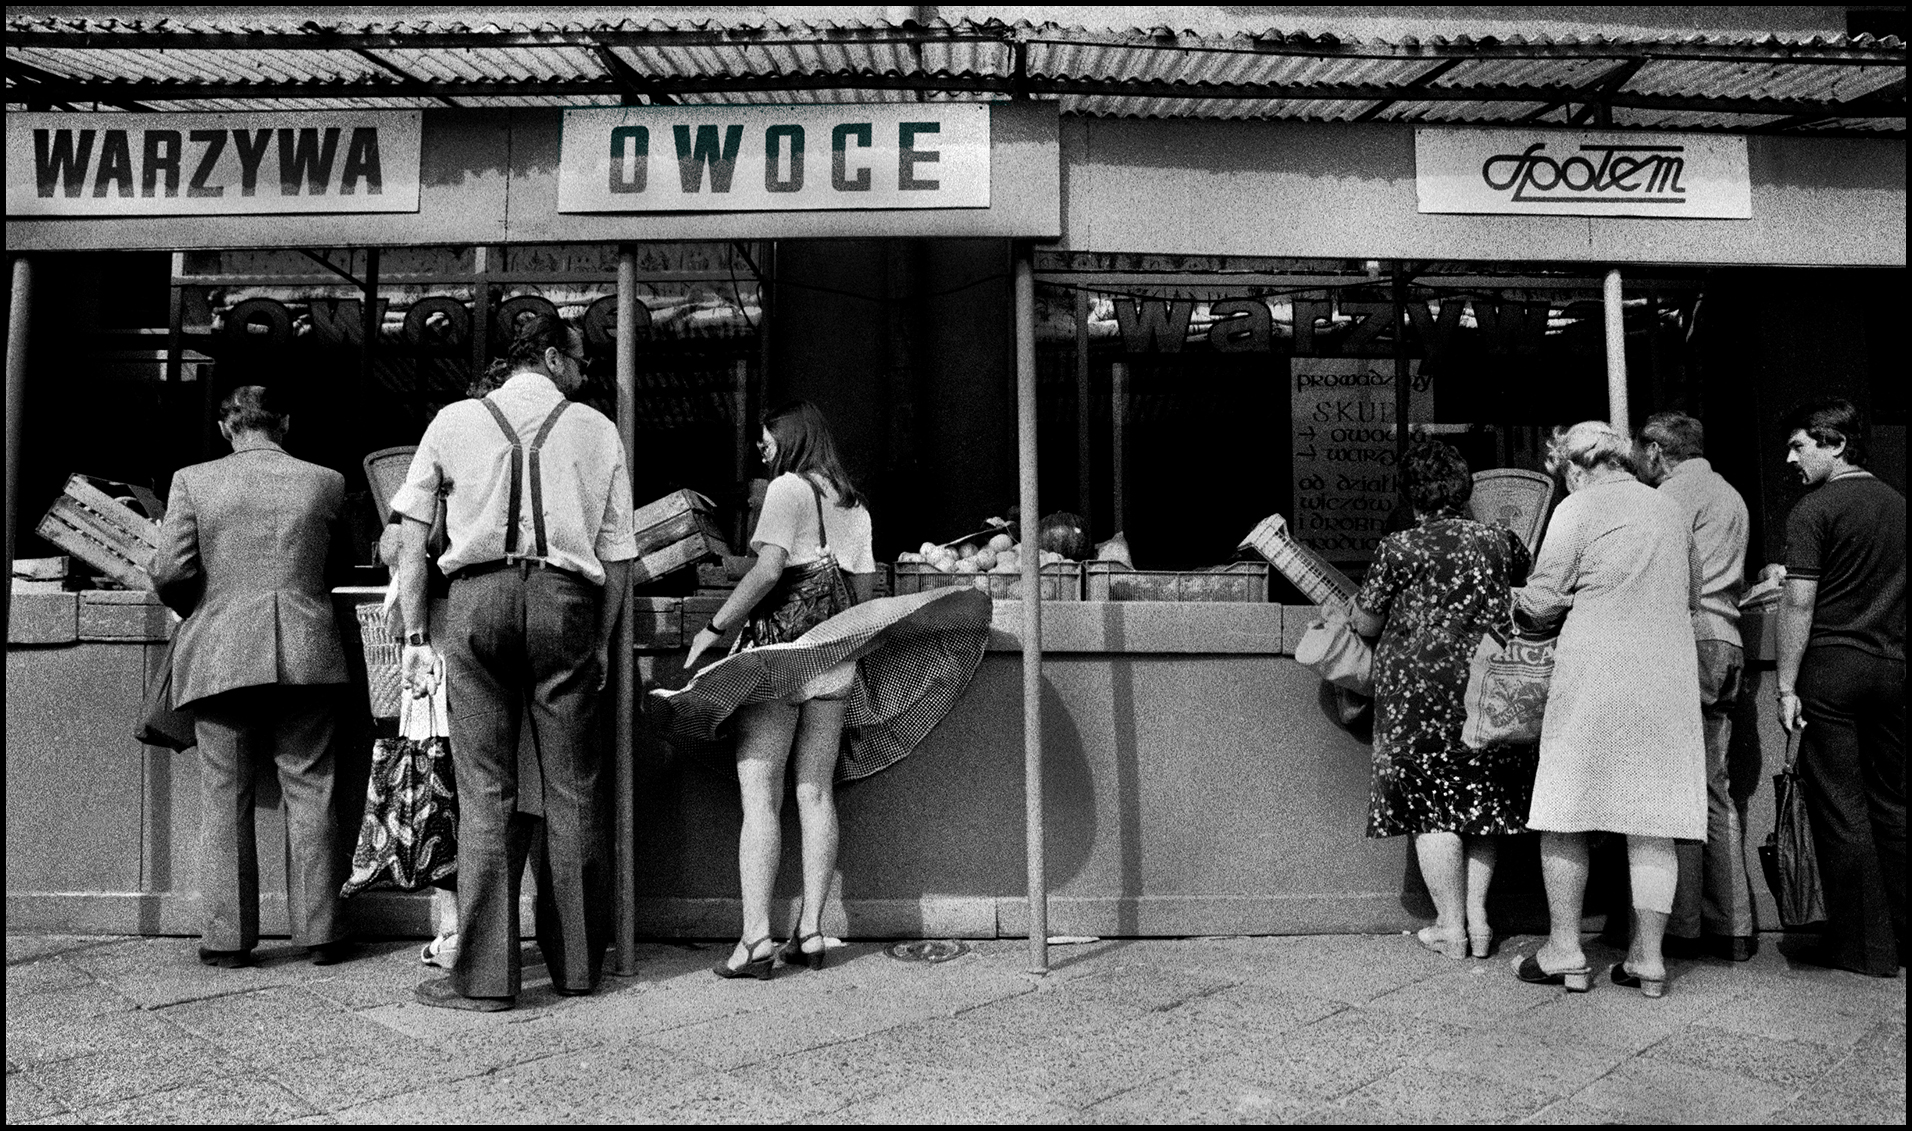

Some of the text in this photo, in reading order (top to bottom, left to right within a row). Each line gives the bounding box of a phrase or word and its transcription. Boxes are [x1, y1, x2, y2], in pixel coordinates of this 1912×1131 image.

[33, 127, 382, 198] WARZYWA
[609, 122, 941, 194] OWOCE
[1300, 473, 1324, 491] od
